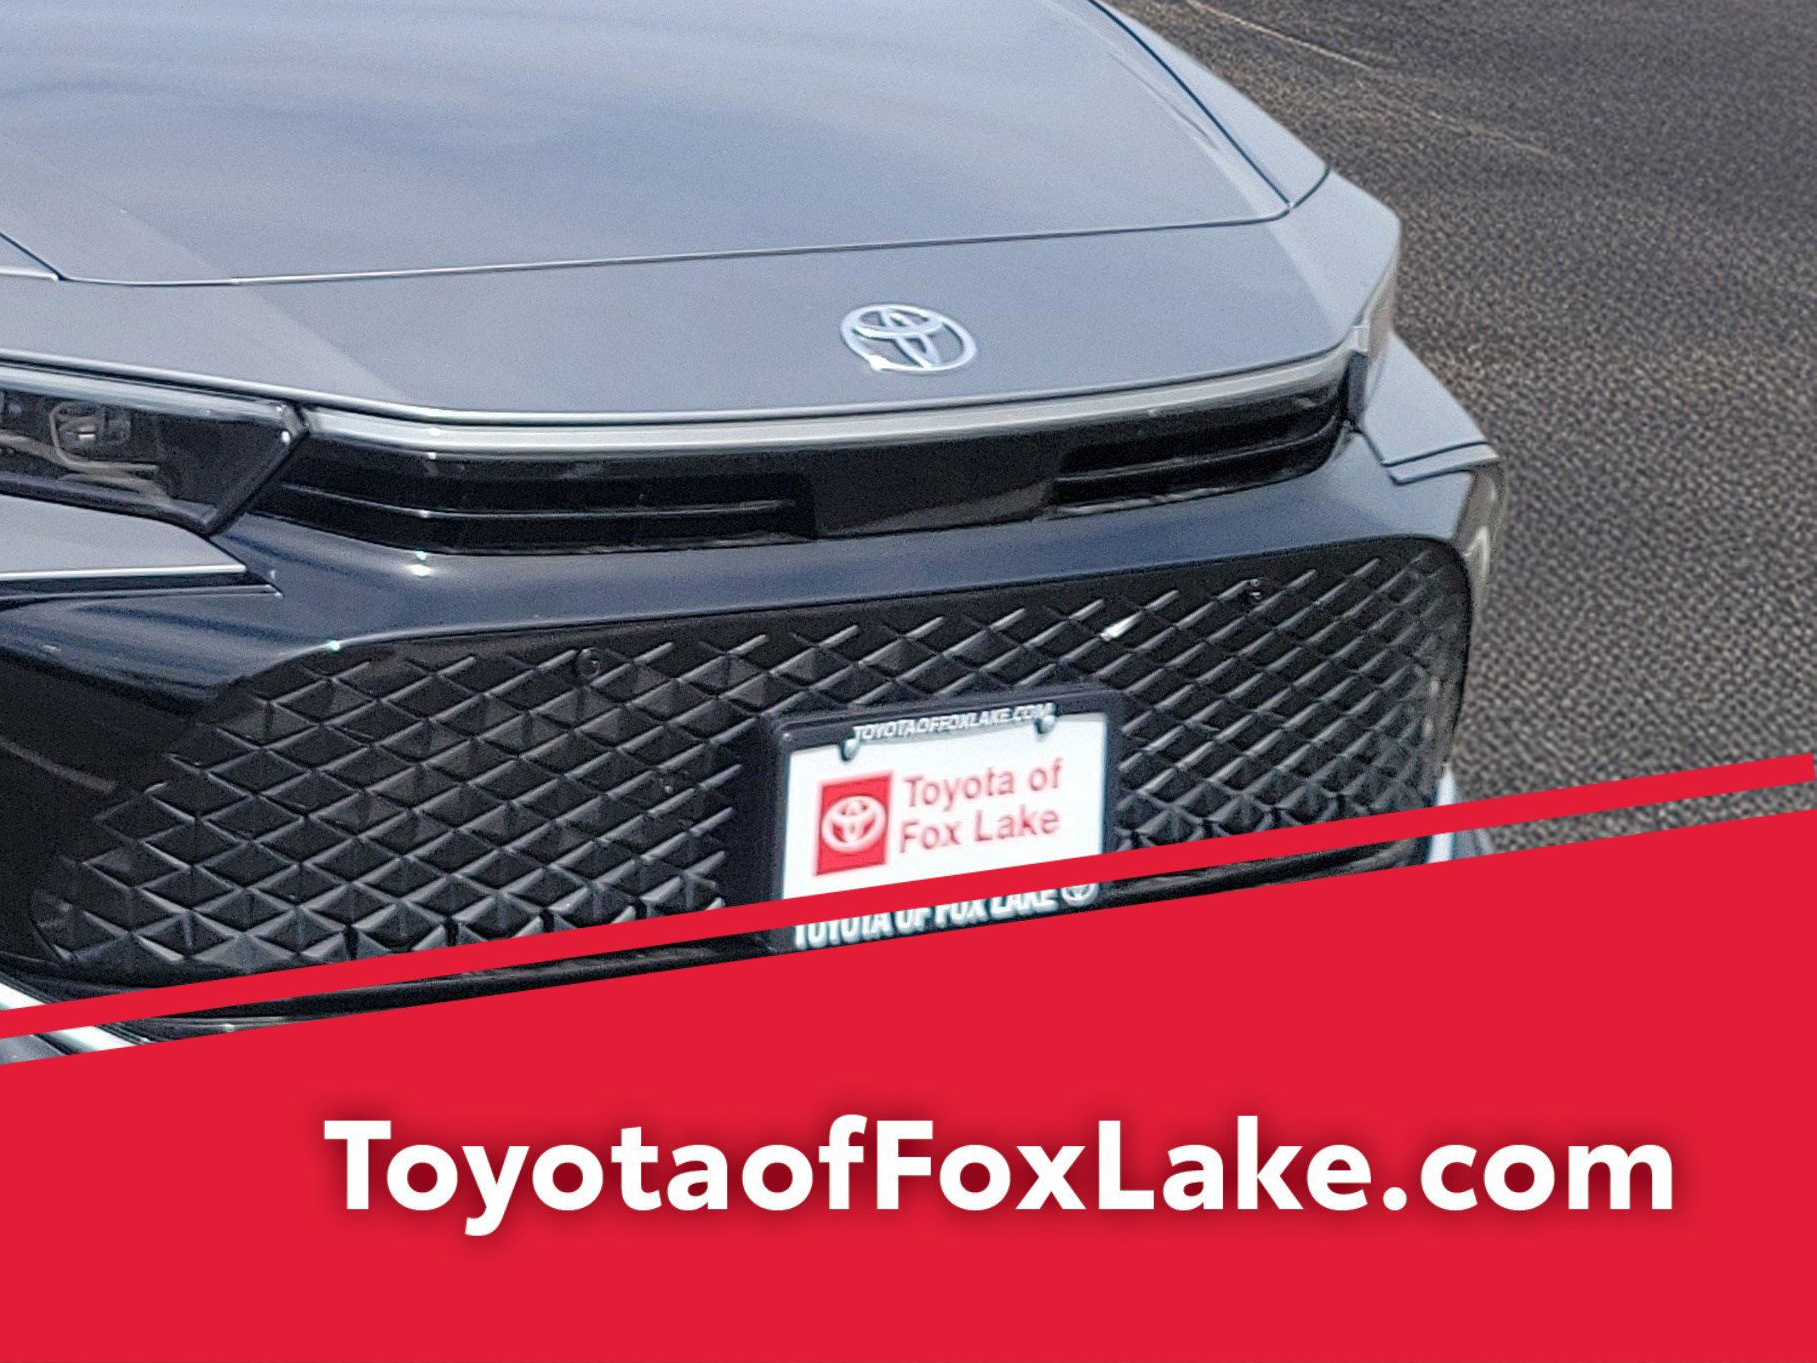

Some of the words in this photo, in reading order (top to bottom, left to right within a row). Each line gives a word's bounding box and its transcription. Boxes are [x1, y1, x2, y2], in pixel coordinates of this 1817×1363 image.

[904, 768, 1015, 812] Toyota
[1028, 758, 1063, 793] of
[900, 817, 961, 854] Fox
[974, 804, 1062, 843] Lake
[988, 888, 1059, 920] LAKE
